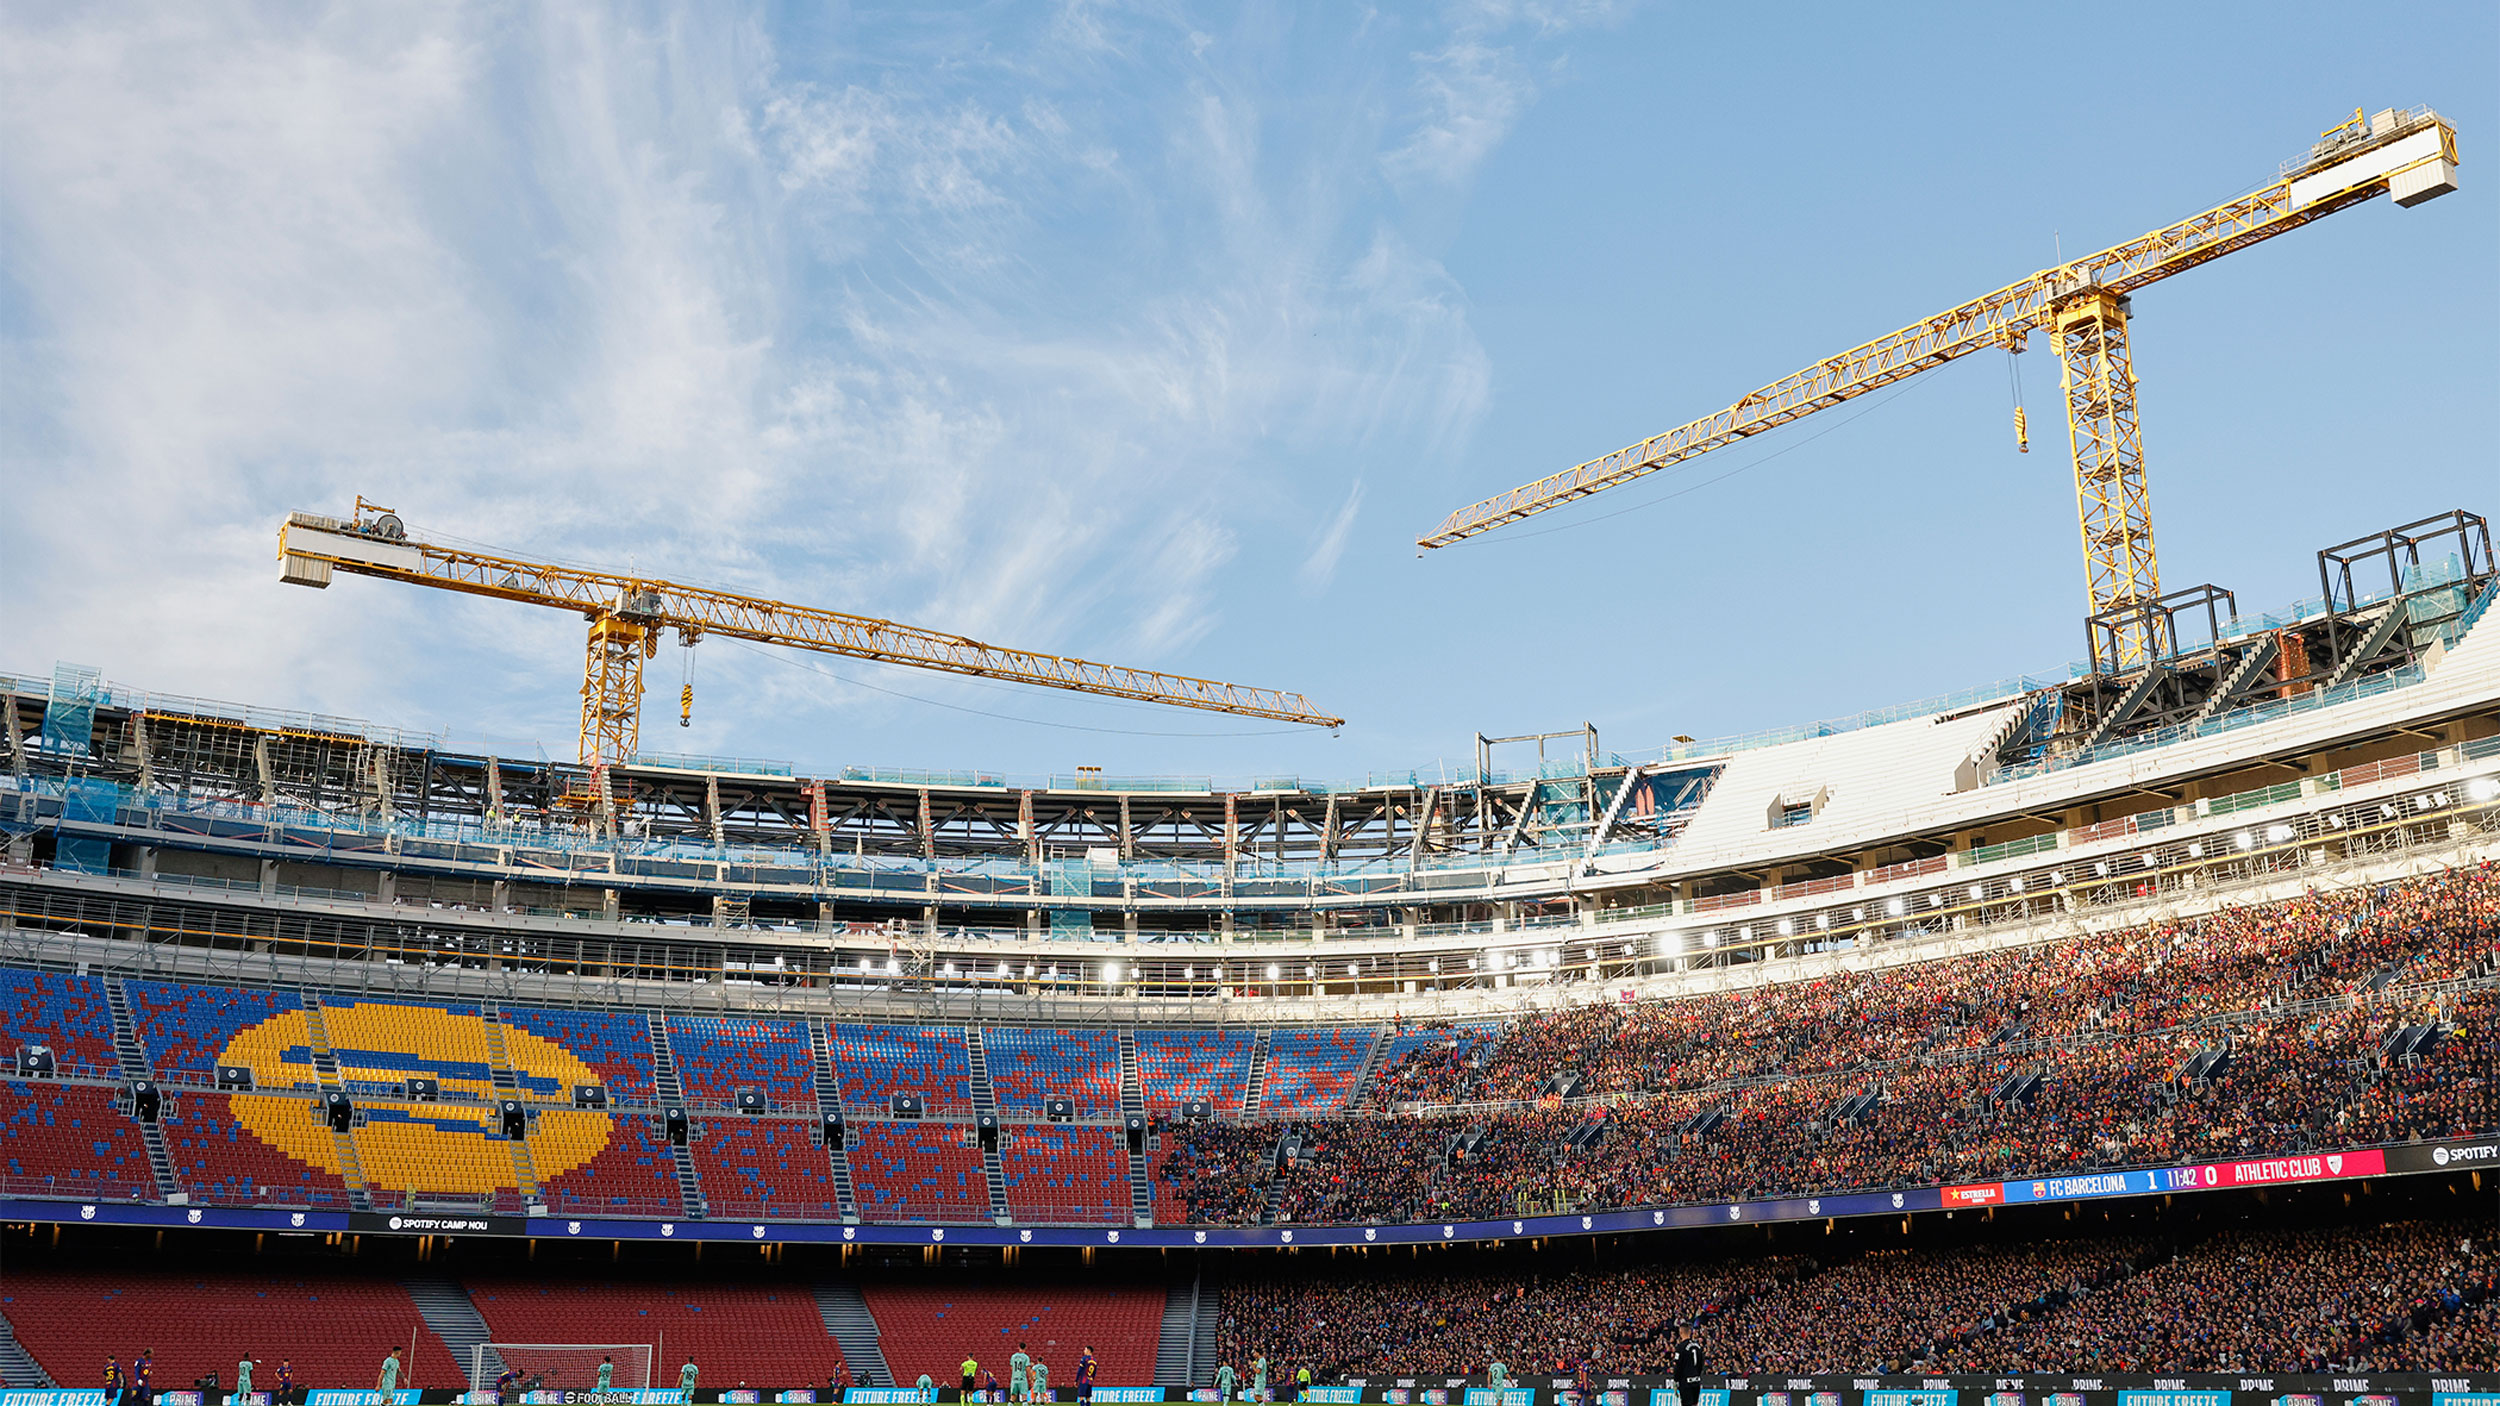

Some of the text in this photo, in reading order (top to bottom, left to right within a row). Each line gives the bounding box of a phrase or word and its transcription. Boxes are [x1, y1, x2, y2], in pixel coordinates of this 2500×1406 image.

[2450, 1145, 2499, 1161] SPOTIFY
[2049, 1157, 2322, 1197] FC BARCELONA 1 11:42 0 ATHLETIC CLUB
[1961, 1189, 1996, 1200] ESTRELLA
[403, 1218, 488, 1229] SPOTIFY CAMP NOU
[1692, 1349, 1698, 1366] 1
[1014, 1361, 1023, 1372] 14
[1088, 1365, 1095, 1376] 9
[1788, 1379, 1811, 1389] PRIME
[1853, 1379, 1879, 1390] PRIME
[1923, 1379, 1949, 1390] PRIME
[2073, 1379, 2102, 1390] PRIME
[2154, 1379, 2185, 1391] PRIME
[2333, 1379, 2368, 1391] PRIME
[2432, 1379, 2470, 1393] PRIME
[4, 1393, 61, 1406] FUTURE
[170, 1394, 198, 1406] PRIME
[315, 1393, 363, 1405] FUTURE
[533, 1393, 558, 1405] PRIME
[731, 1393, 756, 1403] PRIME
[788, 1393, 812, 1403] PRIME
[851, 1391, 890, 1403] FUTURE
[1122, 1391, 1156, 1402] FREEZE
[1198, 1391, 1218, 1402] PRIME
[1330, 1390, 1355, 1403] FREEZE
[1872, 1394, 1909, 1406] FUTURE
[2127, 1395, 2219, 1406] FUTURE FREEZE
